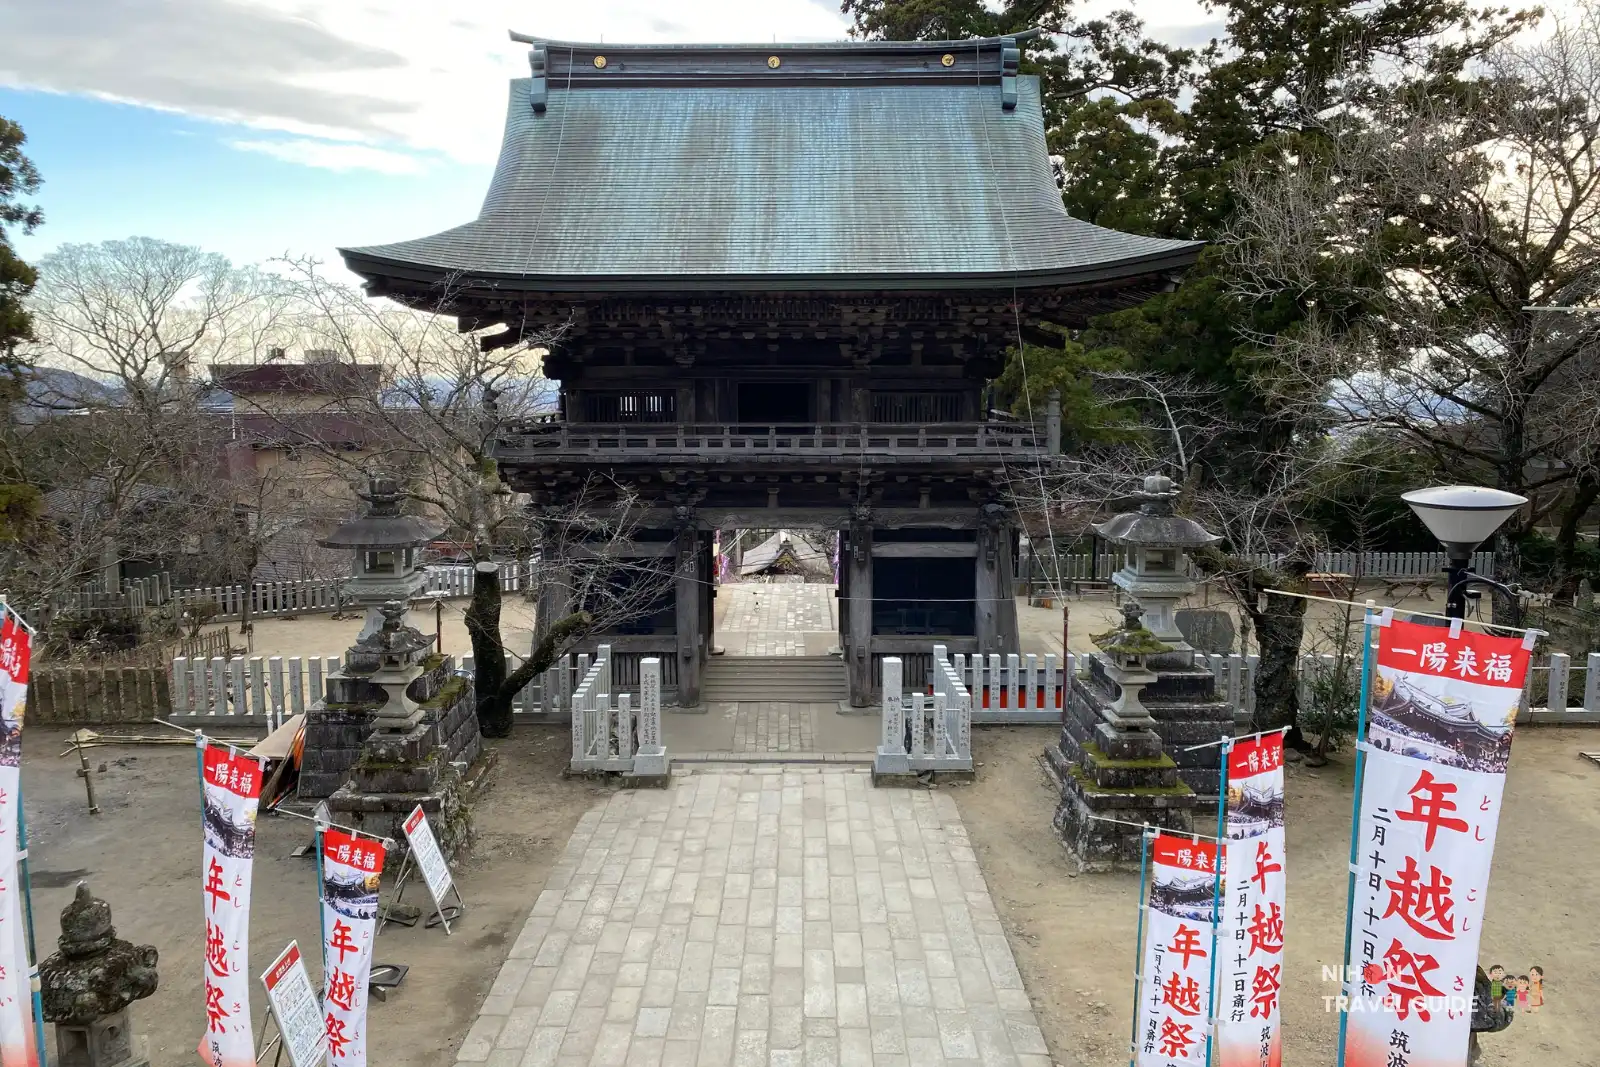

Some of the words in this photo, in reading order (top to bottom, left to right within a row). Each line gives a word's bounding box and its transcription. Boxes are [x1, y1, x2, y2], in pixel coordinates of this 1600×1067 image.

[1391, 641, 1513, 683] 一陽来福
[206, 763, 253, 795] 一陽来福
[327, 844, 376, 870] 一陽来福
[1160, 848, 1226, 873] 一陽来福
[1380, 769, 1470, 1023] 年越祭
[204, 855, 231, 1034] 年越祭
[325, 918, 359, 1059] 年越祭
[1159, 923, 1208, 1058] 年越祭
[1247, 841, 1284, 1020] 年越祭
